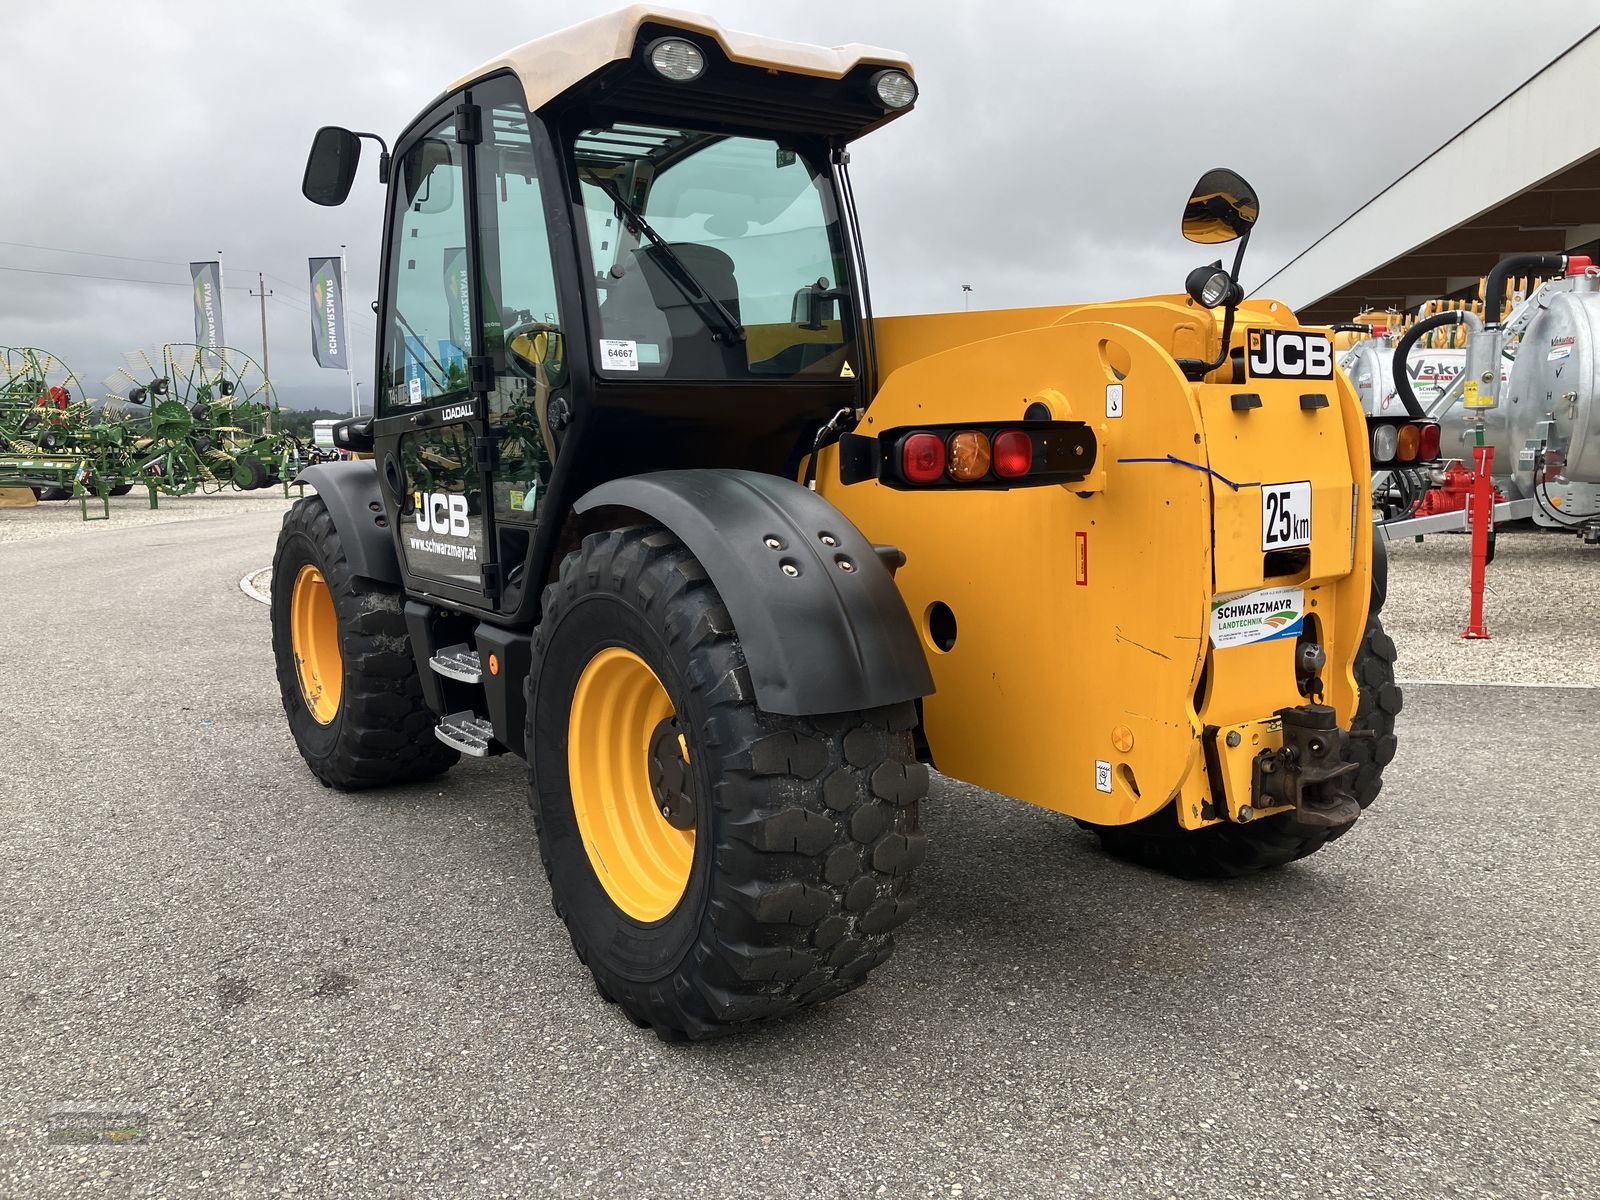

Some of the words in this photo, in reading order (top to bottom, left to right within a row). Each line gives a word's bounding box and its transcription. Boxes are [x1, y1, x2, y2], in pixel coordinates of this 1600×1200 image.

[607, 348, 633, 358] 64667
[1250, 333, 1332, 376] JCB
[1546, 391, 1553, 401] H
[441, 404, 474, 421] LOADALL
[415, 492, 470, 538] JCB
[1266, 491, 1291, 544] 25
[1293, 513, 1309, 540] km
[410, 537, 477, 563] www.schwarzmayr.at
[1217, 599, 1292, 620] SCHWARZMAYR
[1218, 616, 1263, 631] LANDTECHNIK
